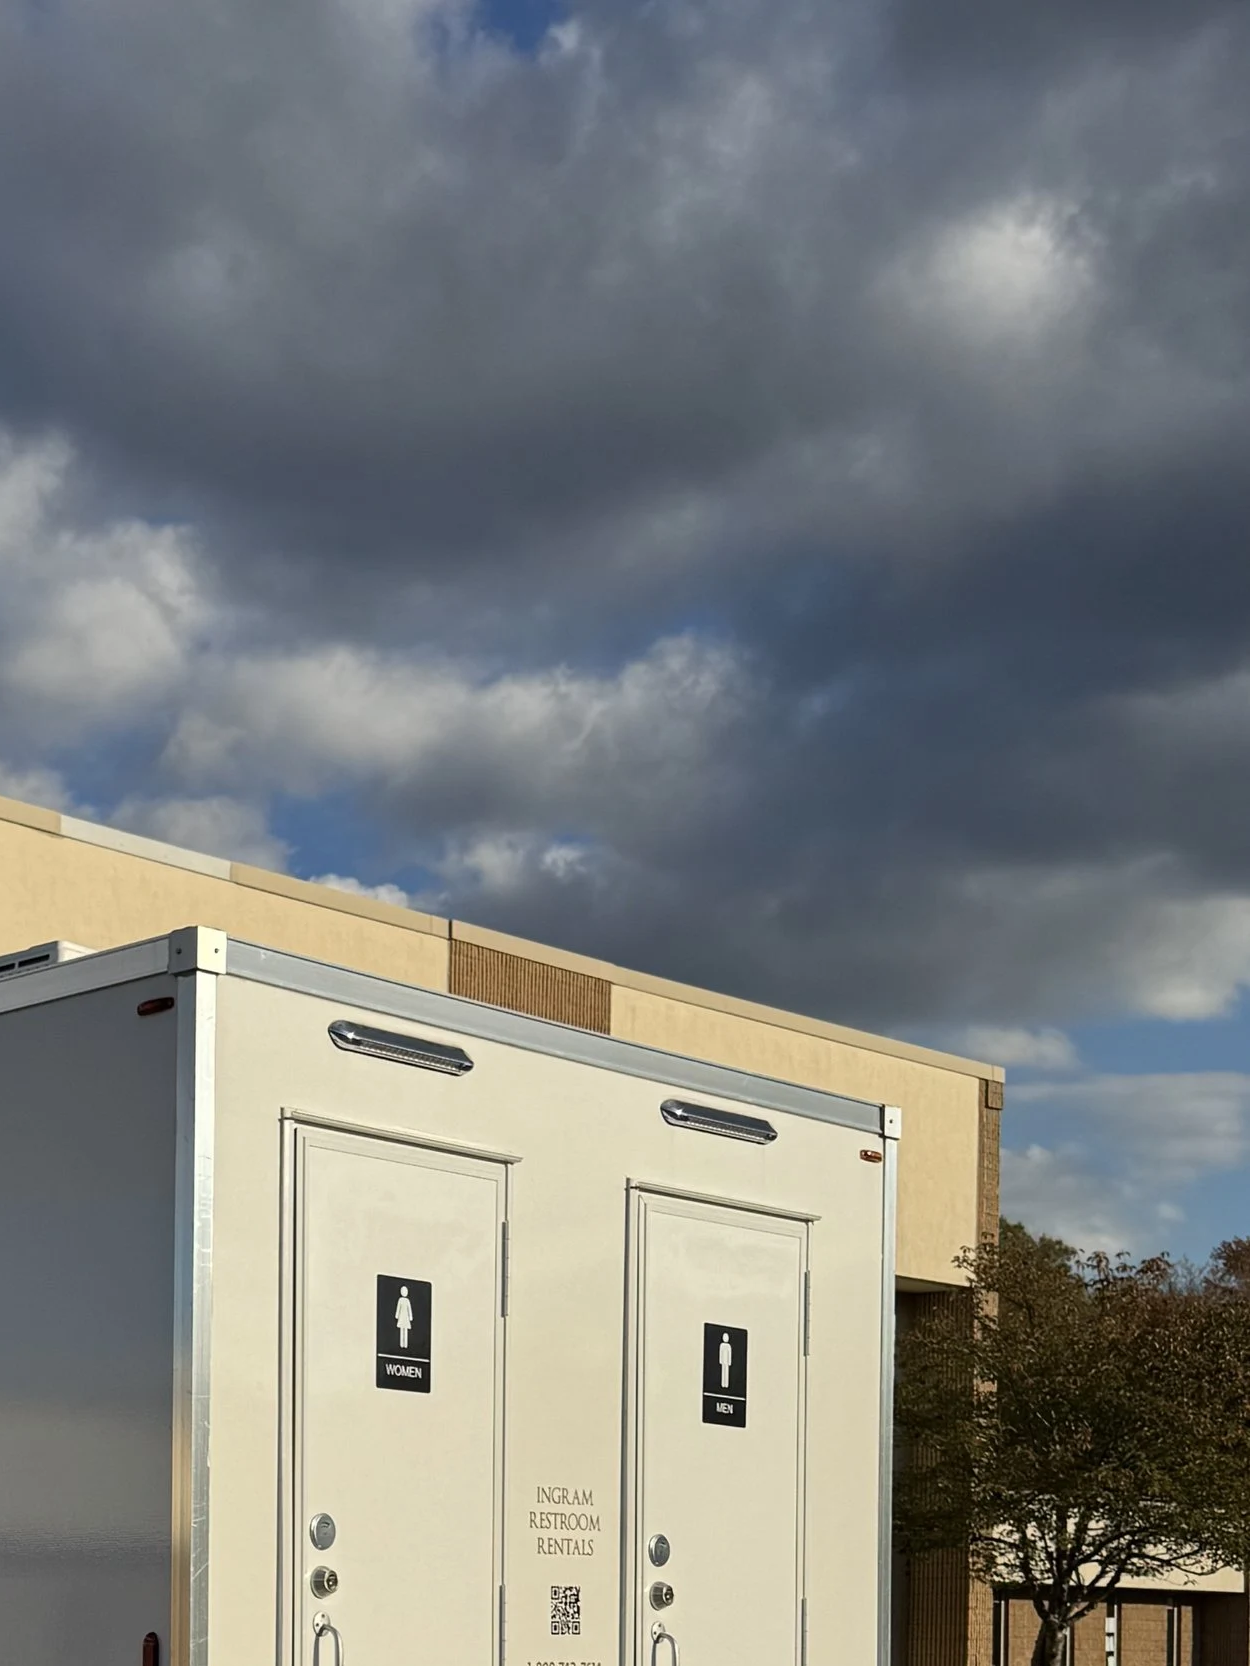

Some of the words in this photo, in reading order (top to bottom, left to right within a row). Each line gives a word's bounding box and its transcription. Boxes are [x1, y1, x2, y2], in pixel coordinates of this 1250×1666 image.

[385, 1363, 422, 1379] WOMEN
[716, 1402, 733, 1414] MEN
[536, 1486, 594, 1506] INGRAM
[529, 1511, 601, 1532] RESTROOM
[537, 1537, 594, 1556] RENTALS
